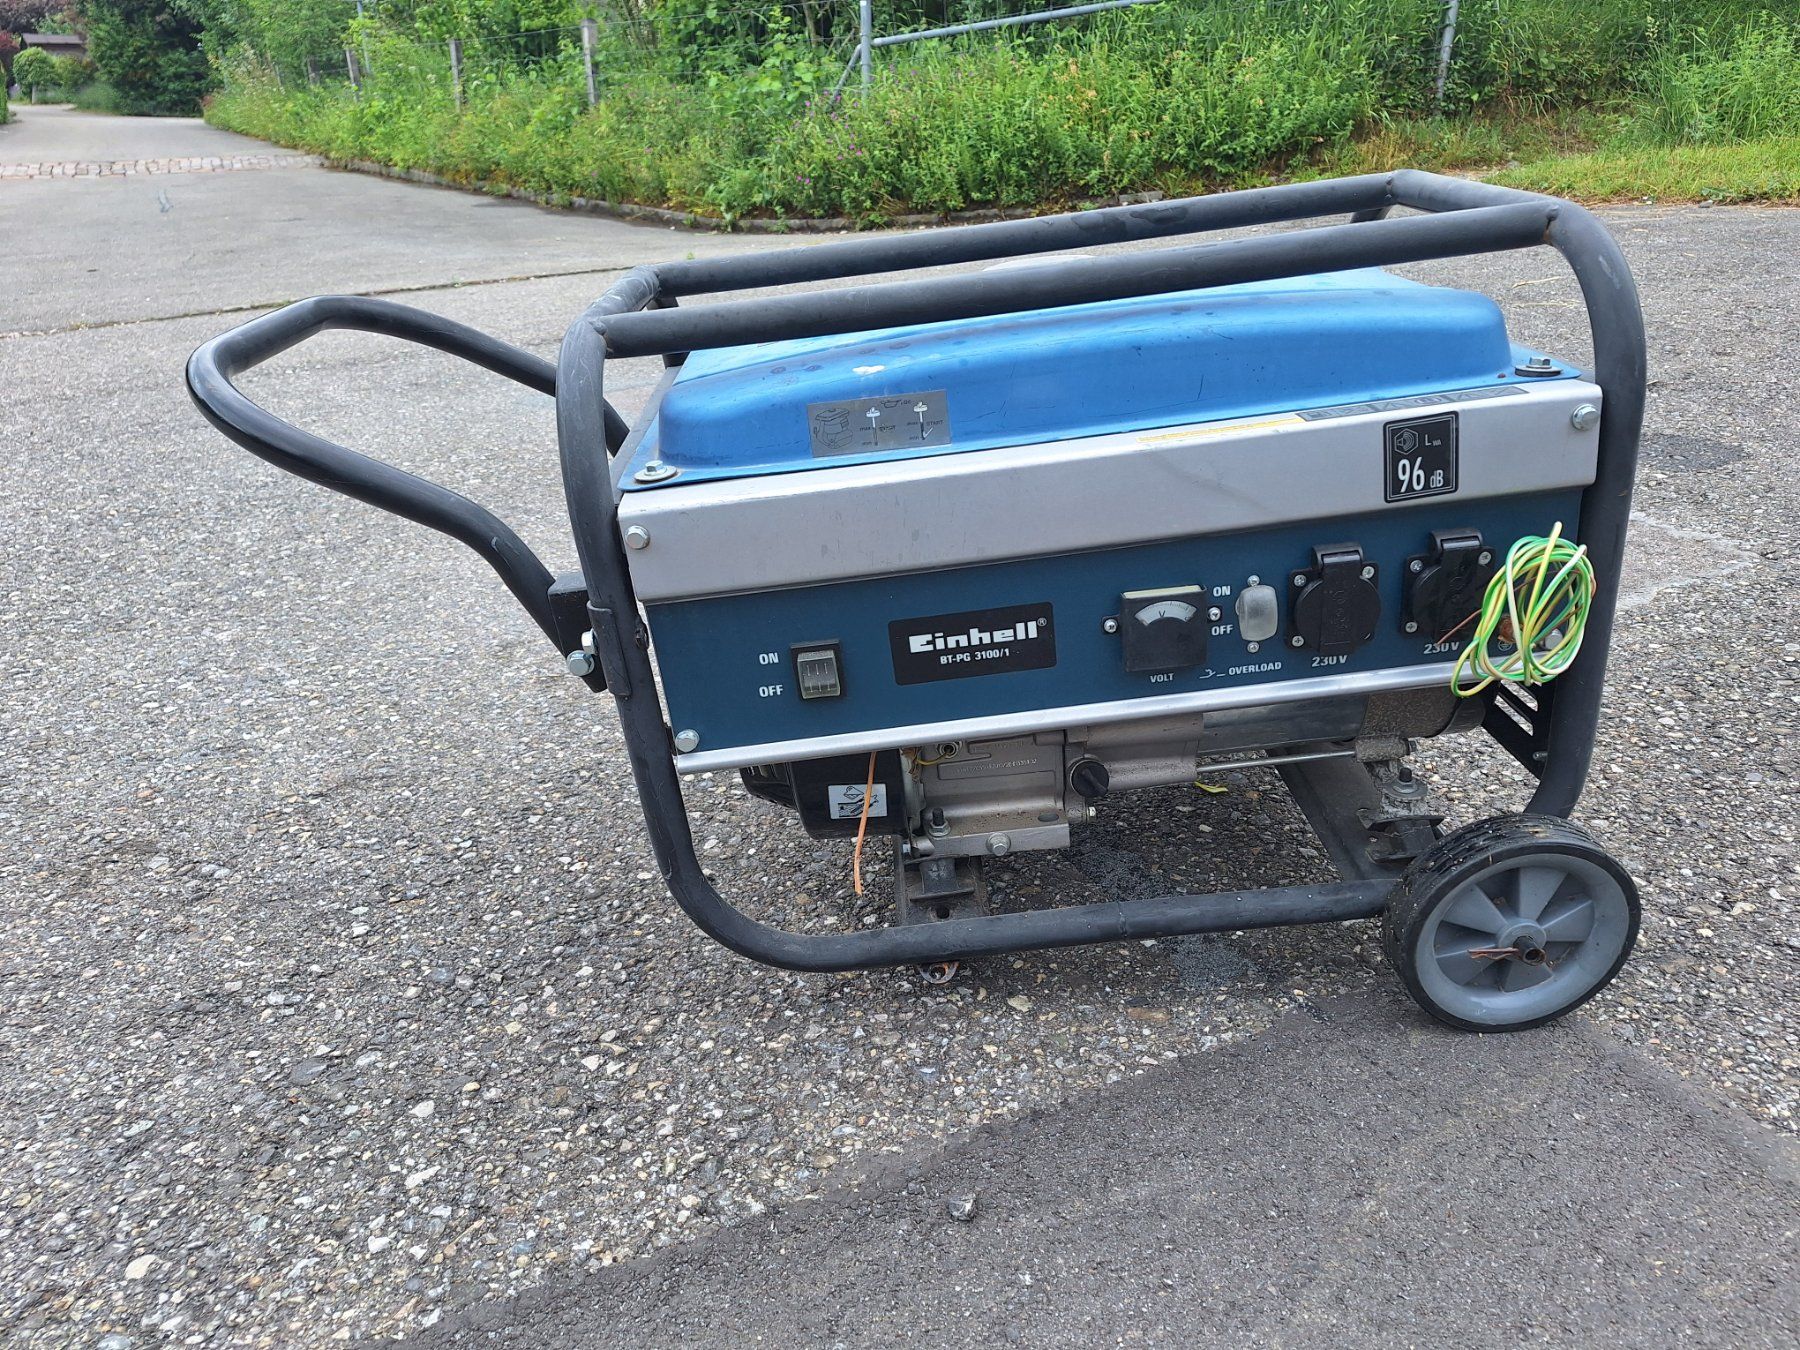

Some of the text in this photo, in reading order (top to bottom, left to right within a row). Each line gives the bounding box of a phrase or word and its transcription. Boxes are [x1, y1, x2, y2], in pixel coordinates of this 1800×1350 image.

[1398, 456, 1444, 493] 96 dB
[1213, 585, 1231, 597] ON
[1158, 609, 1166, 618] V
[1211, 624, 1234, 636] OFF
[759, 652, 779, 665] ON
[940, 648, 1010, 665] BT-PG 3100/1
[1228, 661, 1282, 676] OVERLOAD
[1150, 672, 1175, 683] VOLT
[758, 684, 784, 698] OFF
